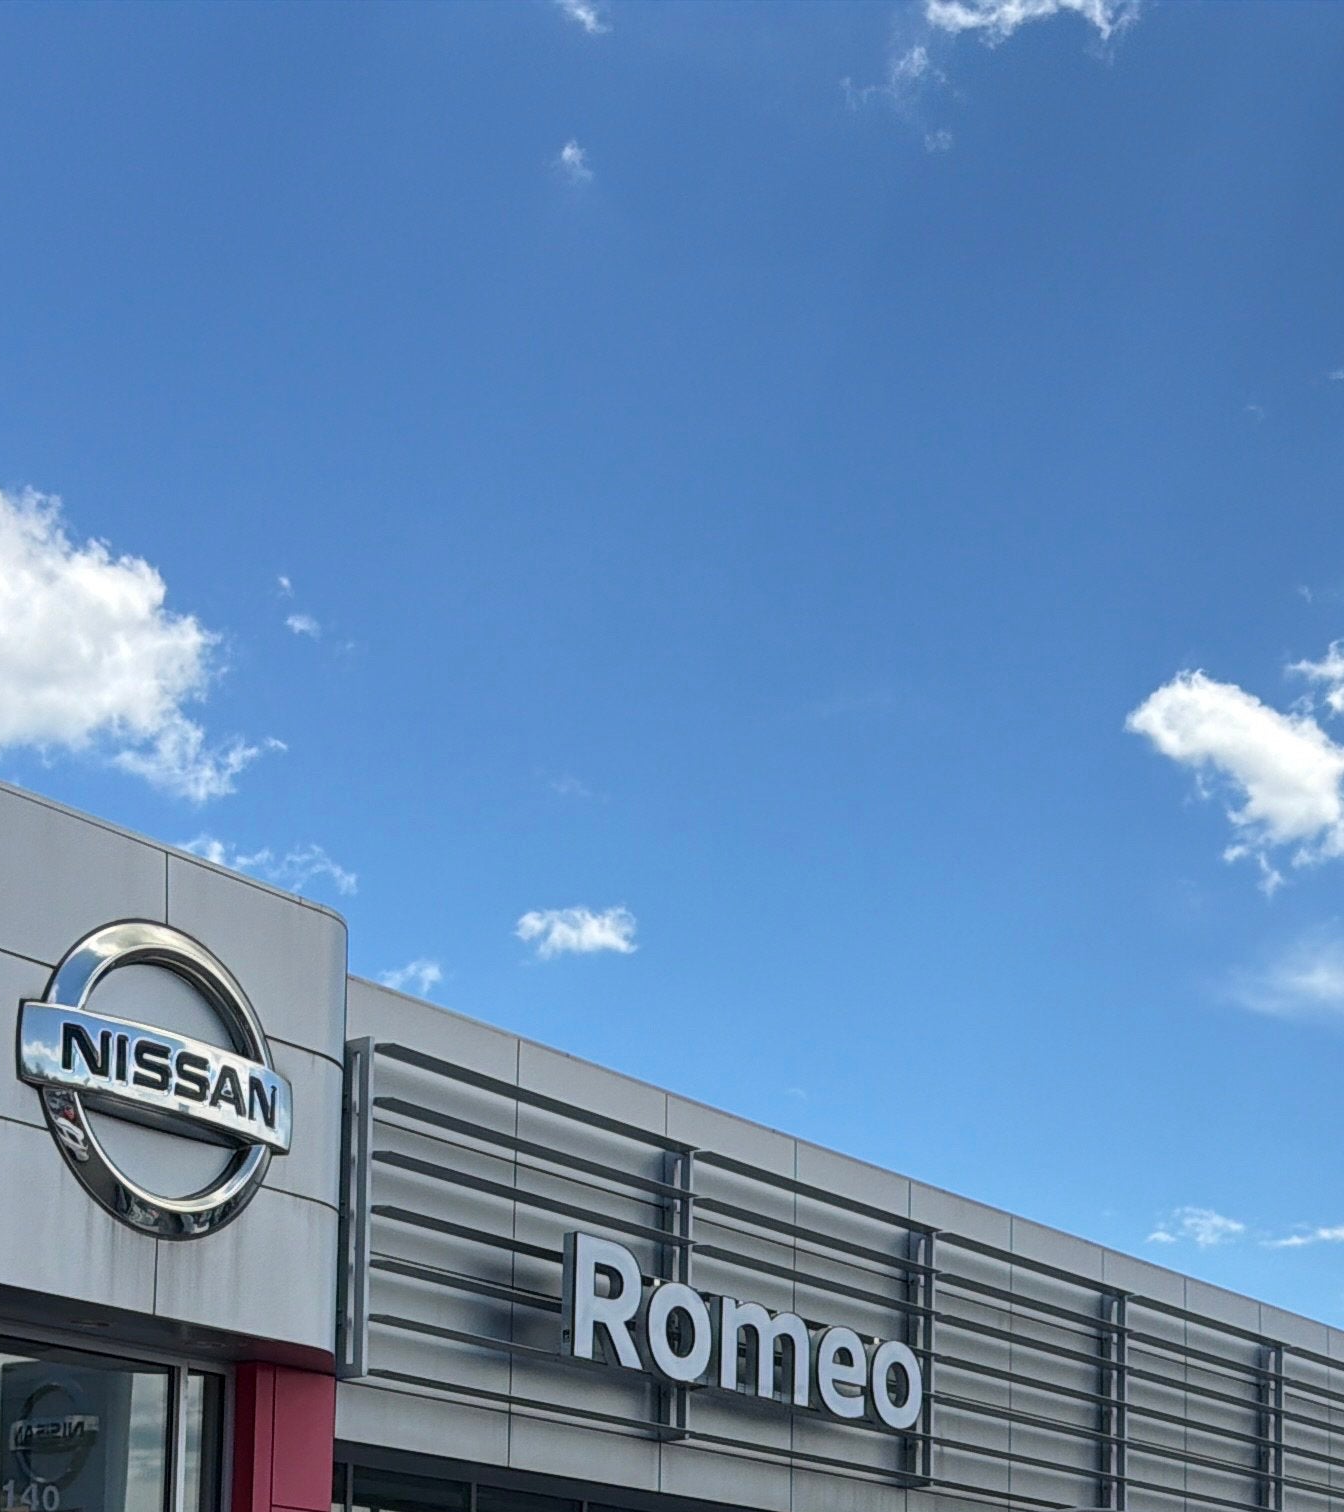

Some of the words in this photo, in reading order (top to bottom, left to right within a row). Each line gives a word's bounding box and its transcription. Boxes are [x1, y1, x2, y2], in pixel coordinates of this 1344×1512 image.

[60, 1021, 277, 1130] NISSAN
[564, 1231, 922, 1430] Romeo
[2, 1479, 60, 1512] 140
